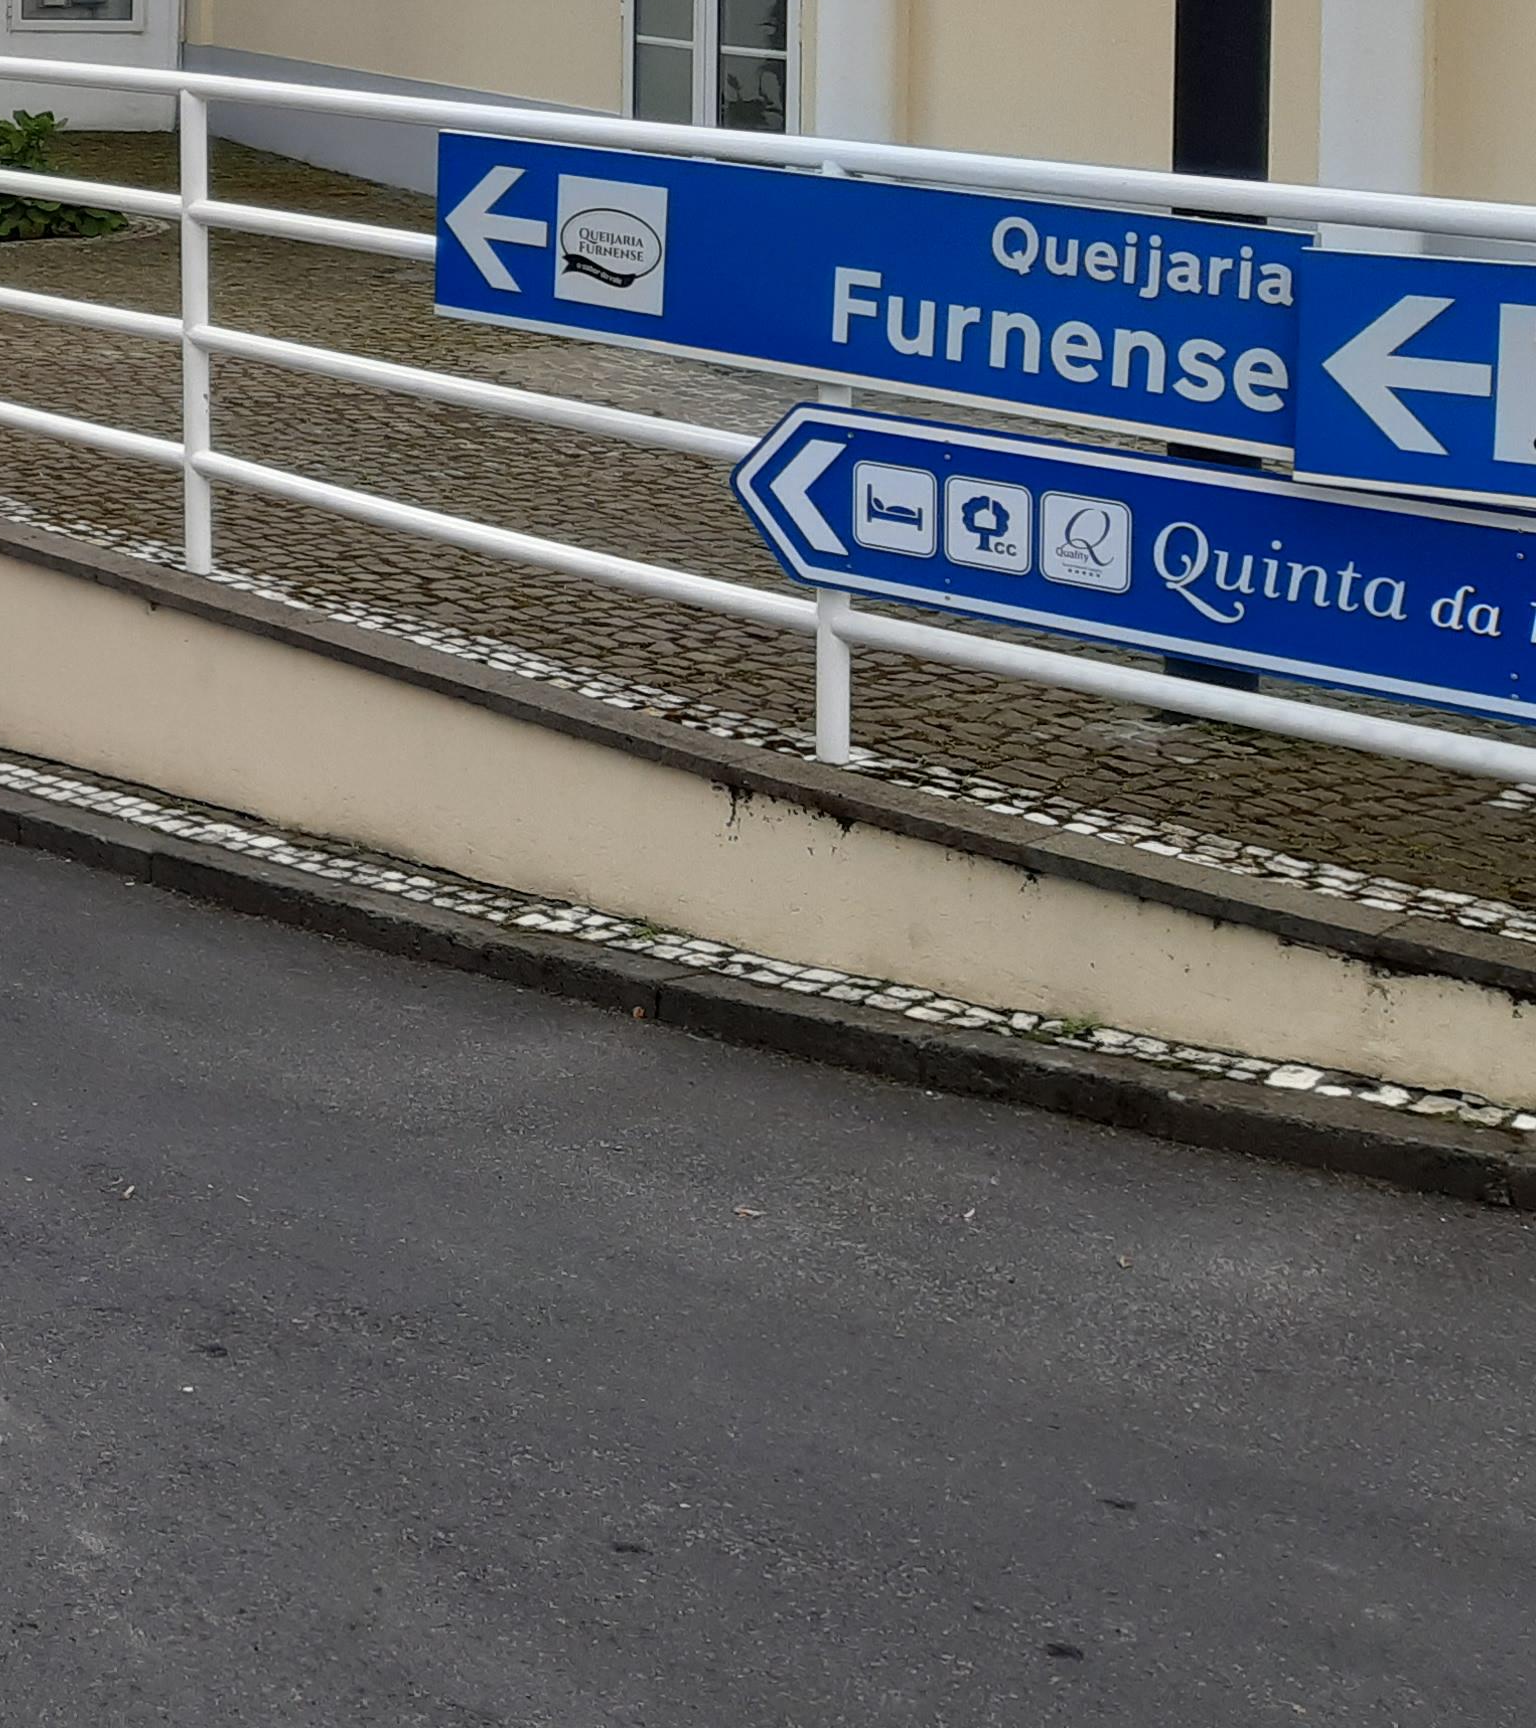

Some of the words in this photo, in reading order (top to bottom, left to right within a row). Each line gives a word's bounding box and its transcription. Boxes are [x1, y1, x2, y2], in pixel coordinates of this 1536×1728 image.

[578, 227, 645, 249] QUEIJARIA
[578, 240, 645, 263] FURNENSE
[991, 216, 1295, 307] Queijaria
[831, 265, 1289, 413] Furnense
[994, 541, 1017, 557] CC
[1056, 546, 1090, 563] Quality
[1153, 521, 1408, 623] Quinta
[1430, 585, 1502, 637] da
